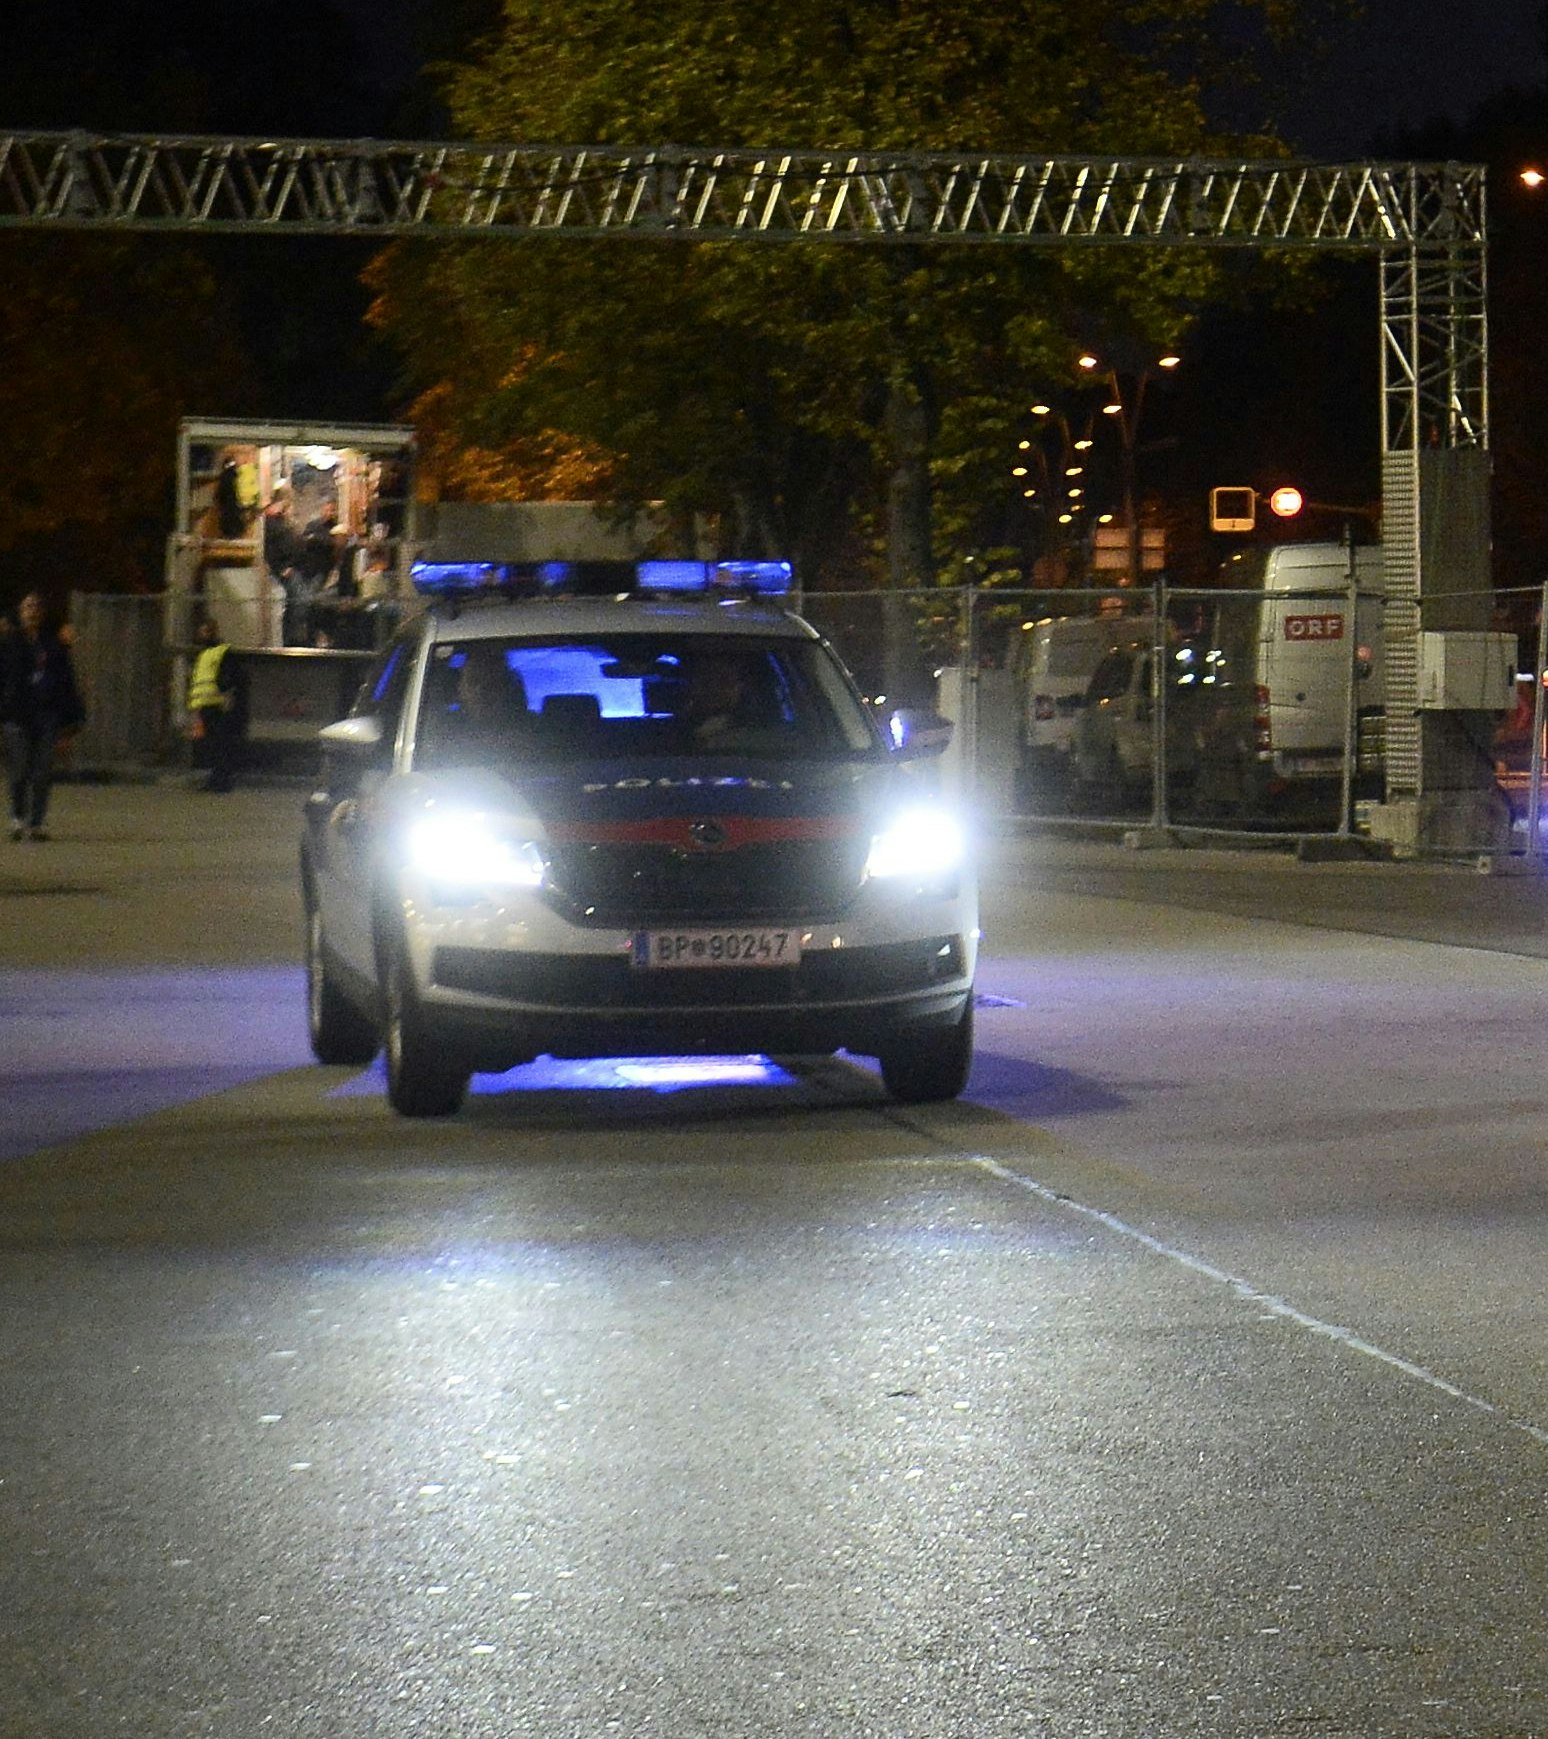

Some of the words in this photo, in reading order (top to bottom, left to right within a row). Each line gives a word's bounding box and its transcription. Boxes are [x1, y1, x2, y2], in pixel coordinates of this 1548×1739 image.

[1290, 619, 1342, 635] ORF
[658, 935, 688, 959] BP
[709, 933, 788, 959] 90247
